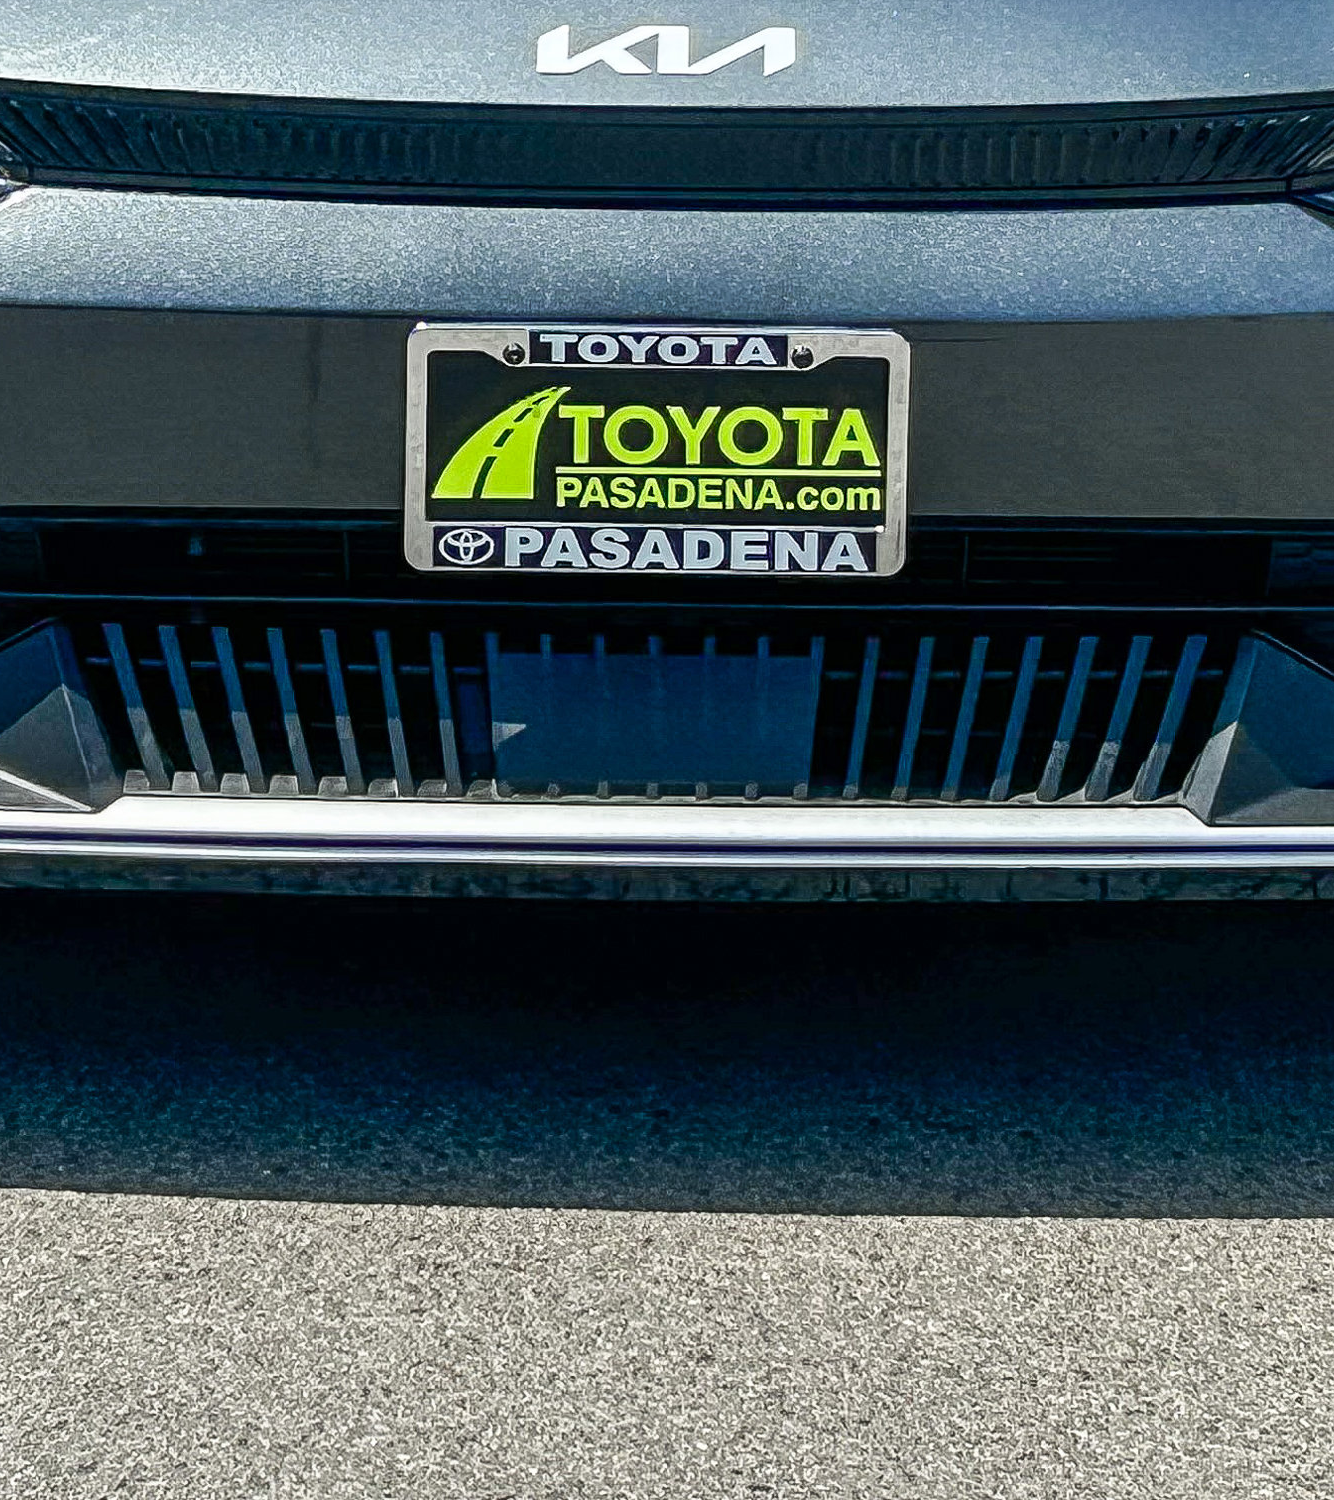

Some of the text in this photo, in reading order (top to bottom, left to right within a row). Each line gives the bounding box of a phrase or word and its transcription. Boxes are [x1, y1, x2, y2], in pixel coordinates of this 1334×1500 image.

[539, 333, 777, 365] TOYOTA
[558, 404, 882, 467] TOYOTA
[556, 476, 881, 511] PASADENA.com
[505, 528, 868, 571] PASADENA
